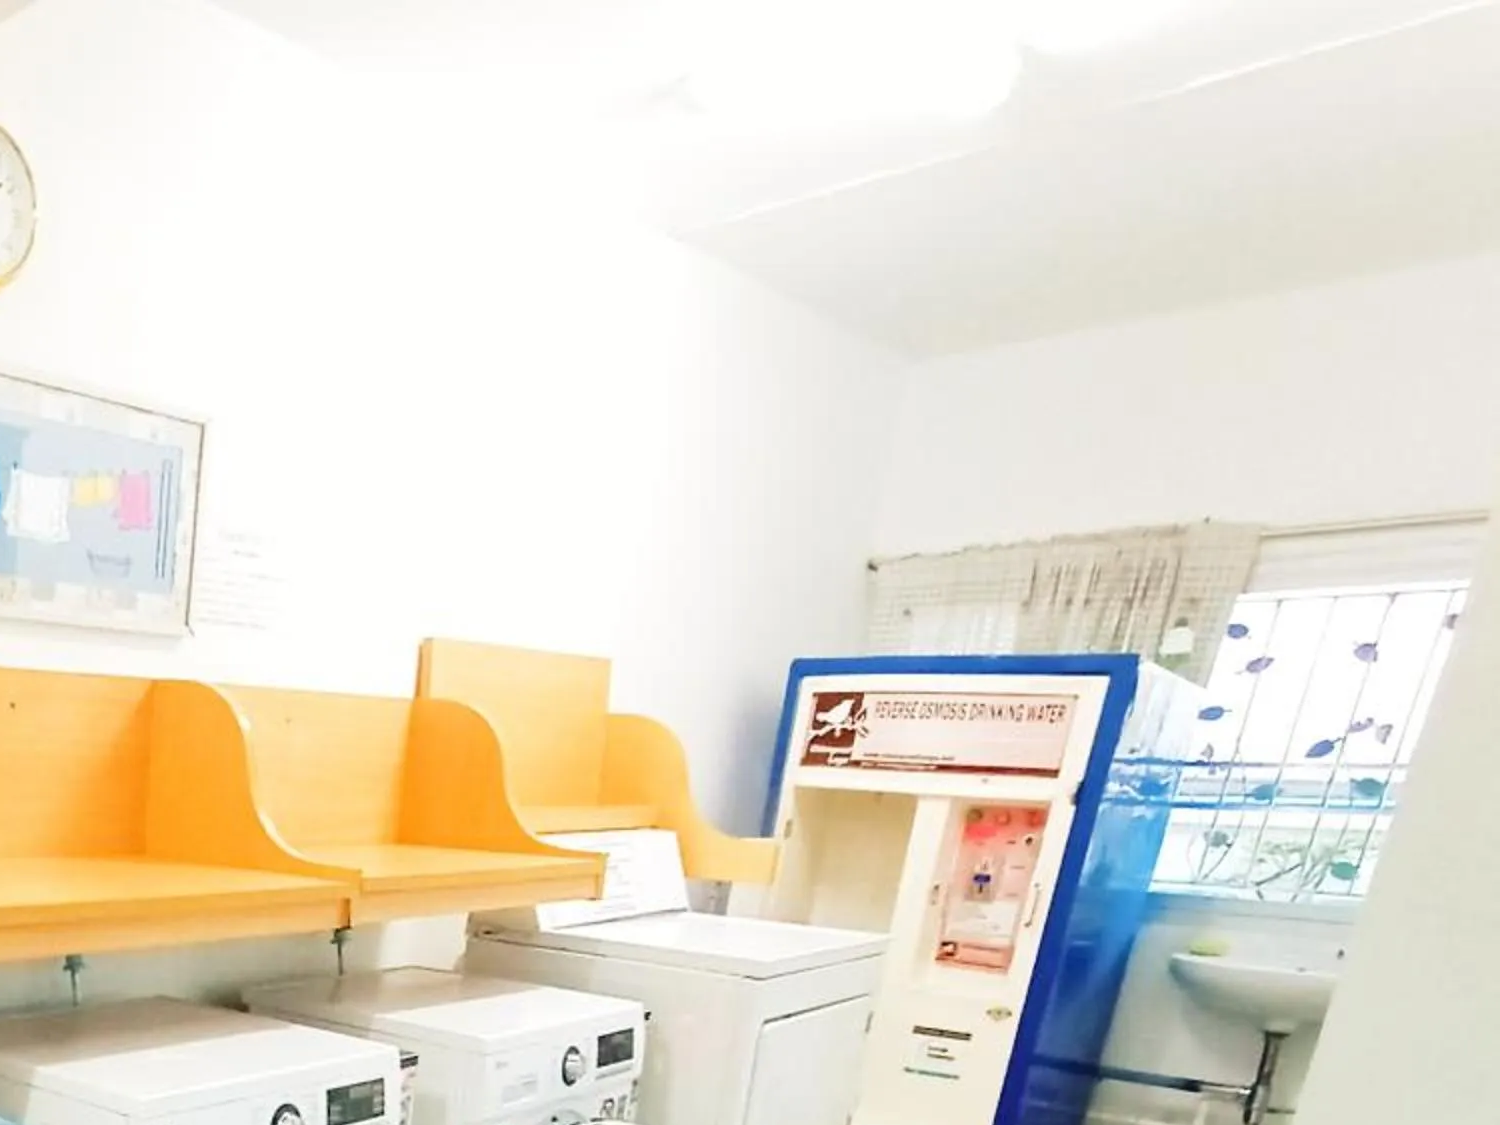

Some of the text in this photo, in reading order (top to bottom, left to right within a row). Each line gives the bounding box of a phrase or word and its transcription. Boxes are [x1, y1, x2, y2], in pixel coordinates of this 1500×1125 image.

[875, 701, 1067, 723] REVERSE OSMOSIS DRINKING WATER
